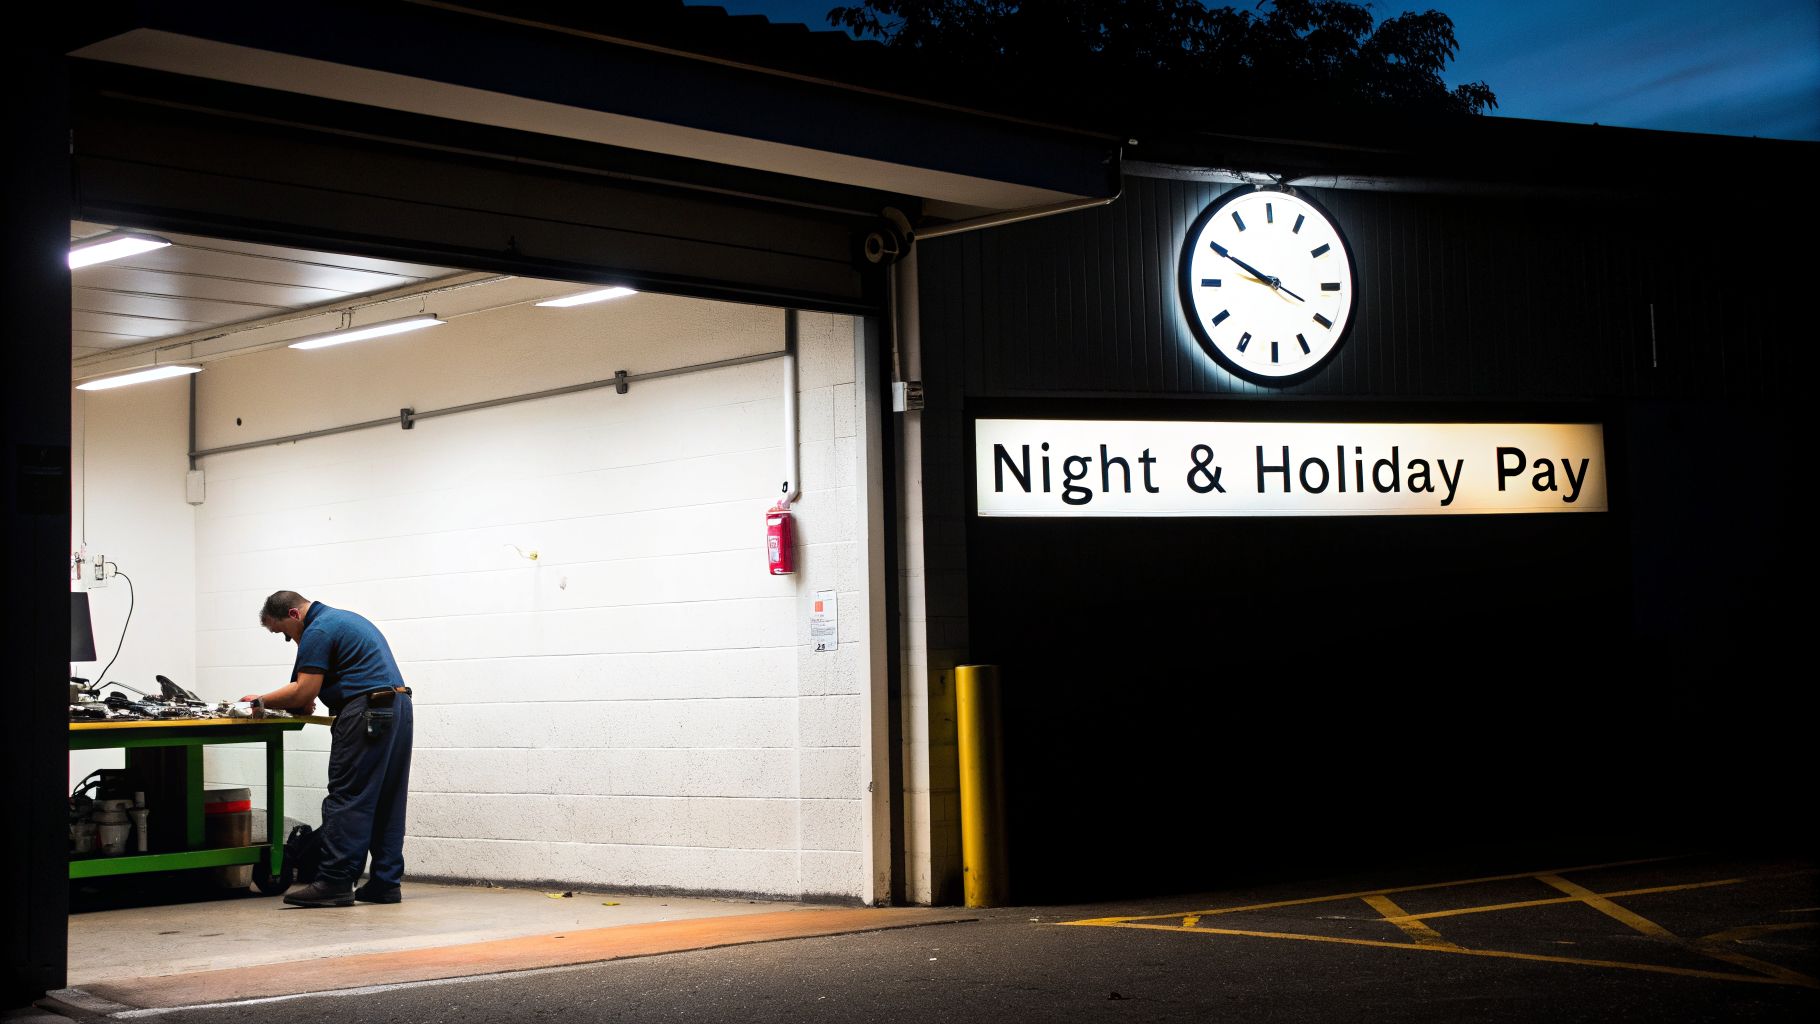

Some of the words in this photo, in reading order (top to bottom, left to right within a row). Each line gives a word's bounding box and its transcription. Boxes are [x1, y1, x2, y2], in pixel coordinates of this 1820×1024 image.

[993, 441, 1160, 506] Night
[1186, 444, 1228, 494] &
[1256, 445, 1464, 507] Holiday
[1496, 446, 1590, 503] Pay
